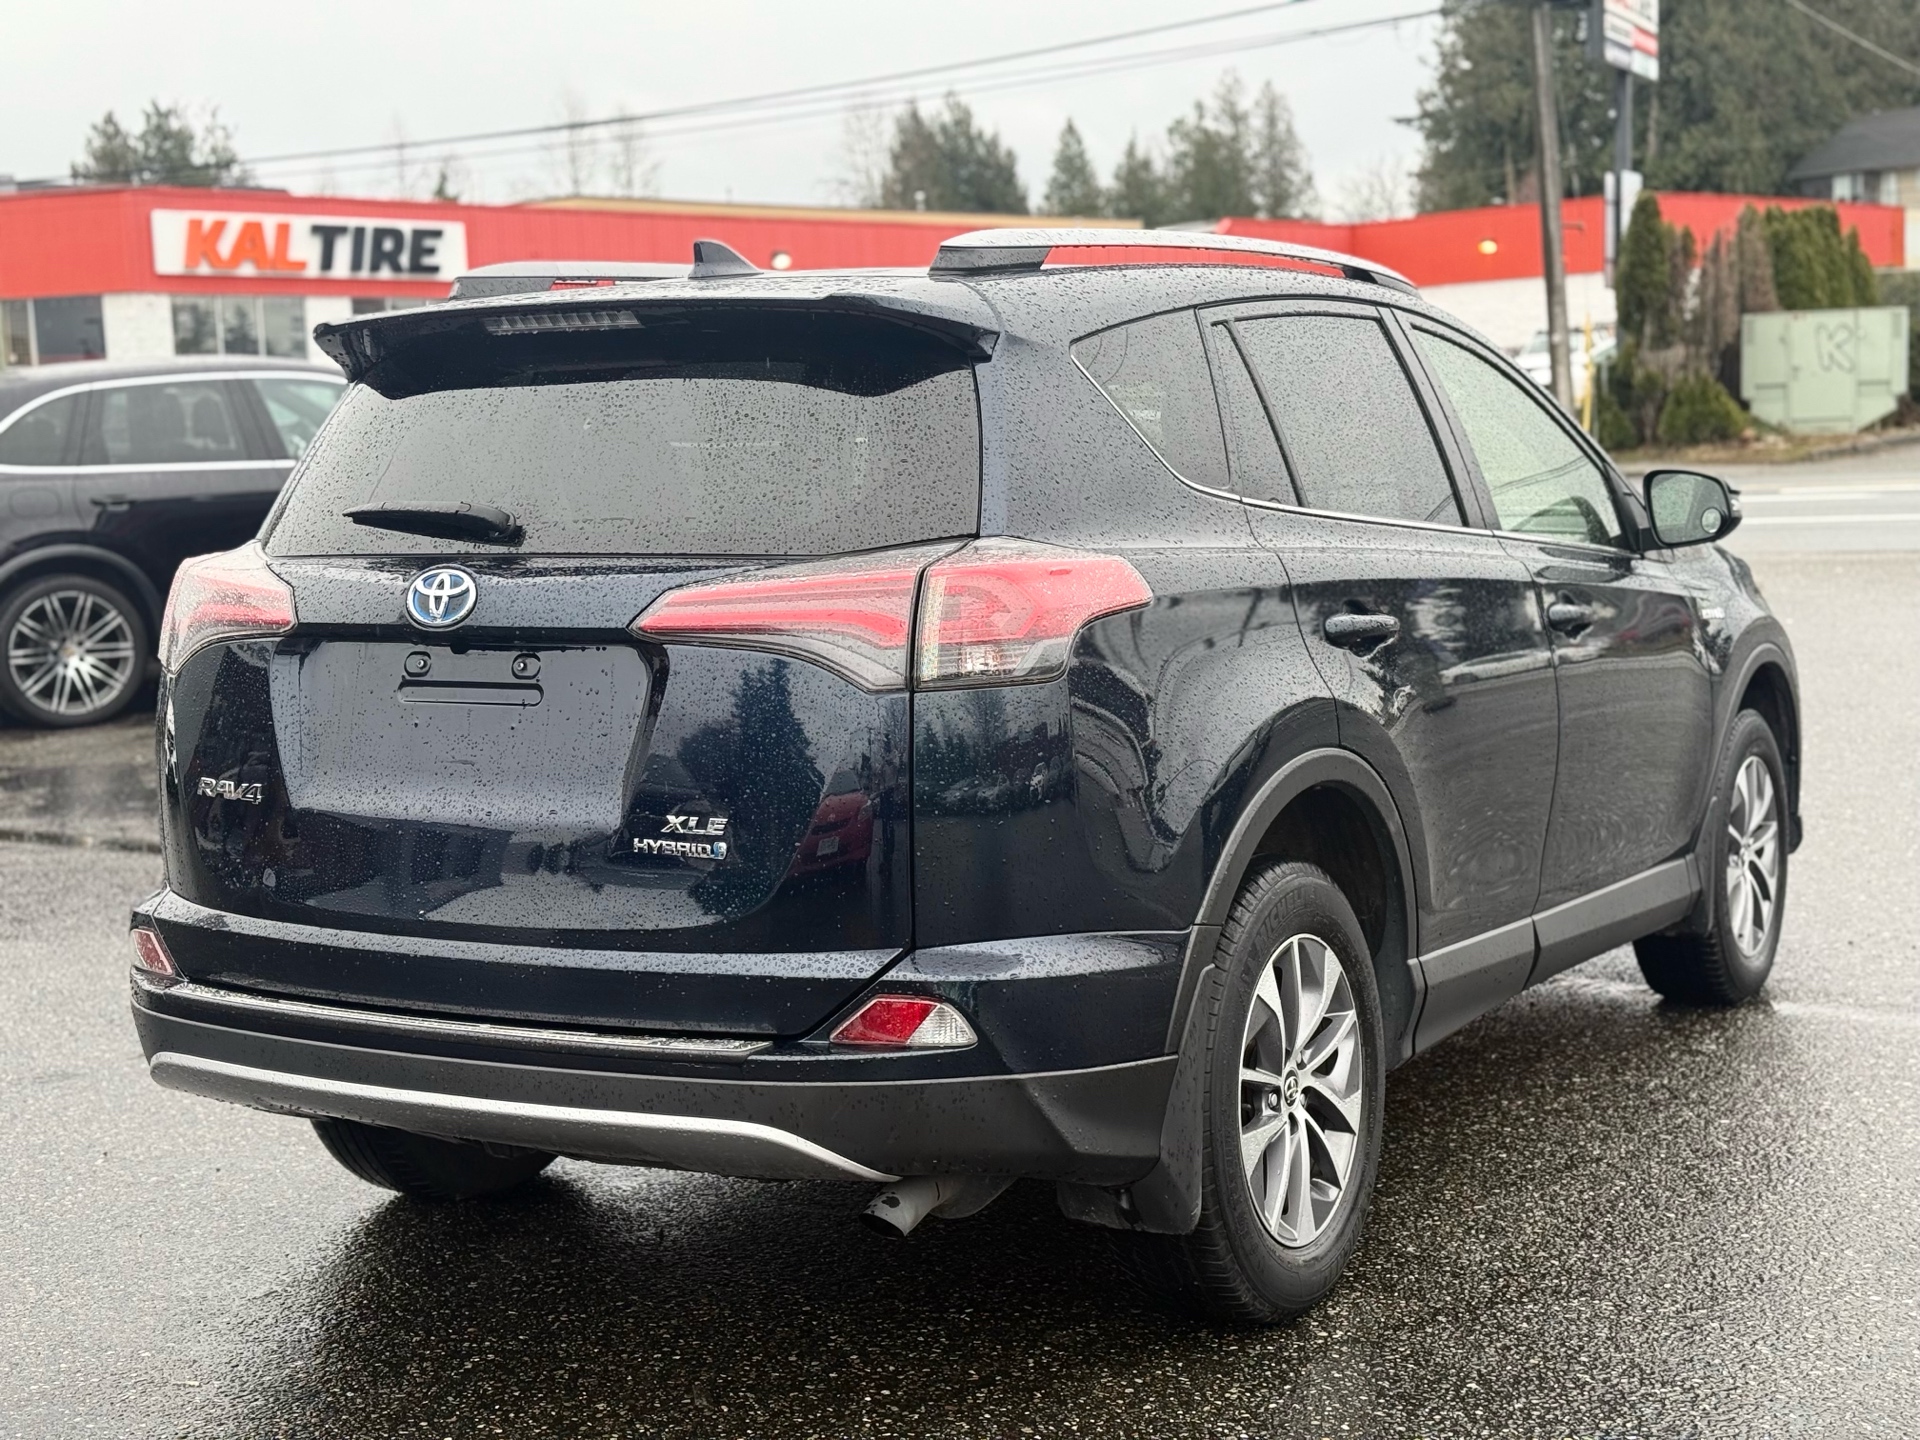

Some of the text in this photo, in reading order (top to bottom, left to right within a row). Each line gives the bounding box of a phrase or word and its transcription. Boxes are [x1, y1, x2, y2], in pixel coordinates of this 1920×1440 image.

[185, 218, 443, 274] KAL TIRE
[197, 777, 262, 805] RAV4
[660, 814, 729, 835] XLE
[633, 837, 712, 858] HYBRID
